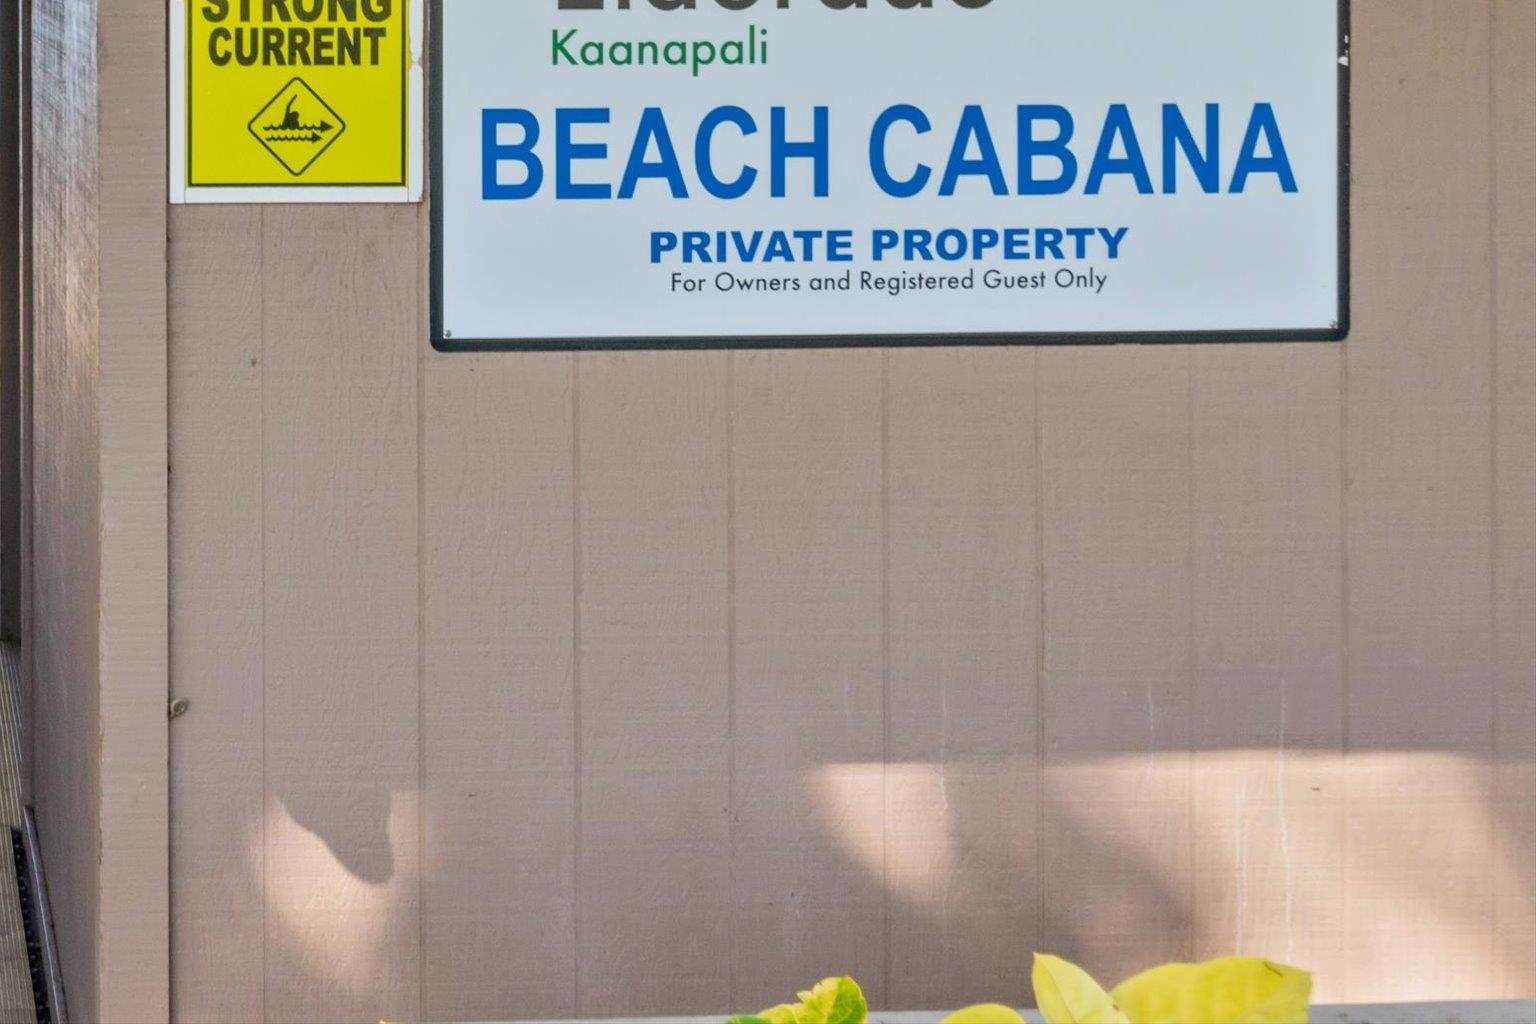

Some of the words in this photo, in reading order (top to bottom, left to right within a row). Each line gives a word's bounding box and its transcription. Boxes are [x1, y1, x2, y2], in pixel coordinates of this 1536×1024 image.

[208, 26, 387, 67] CURRENT
[551, 24, 768, 77] Kaanapali
[481, 105, 829, 201] BEACH
[868, 102, 1299, 199] CABANA
[650, 229, 854, 264] PRIVATE
[872, 227, 1128, 262] PROPERTY
[671, 272, 706, 292] For
[714, 271, 800, 292] Owners
[809, 269, 850, 291] and
[860, 268, 974, 296] Registered
[982, 269, 1046, 289] Guest
[1054, 266, 1108, 294] Only
